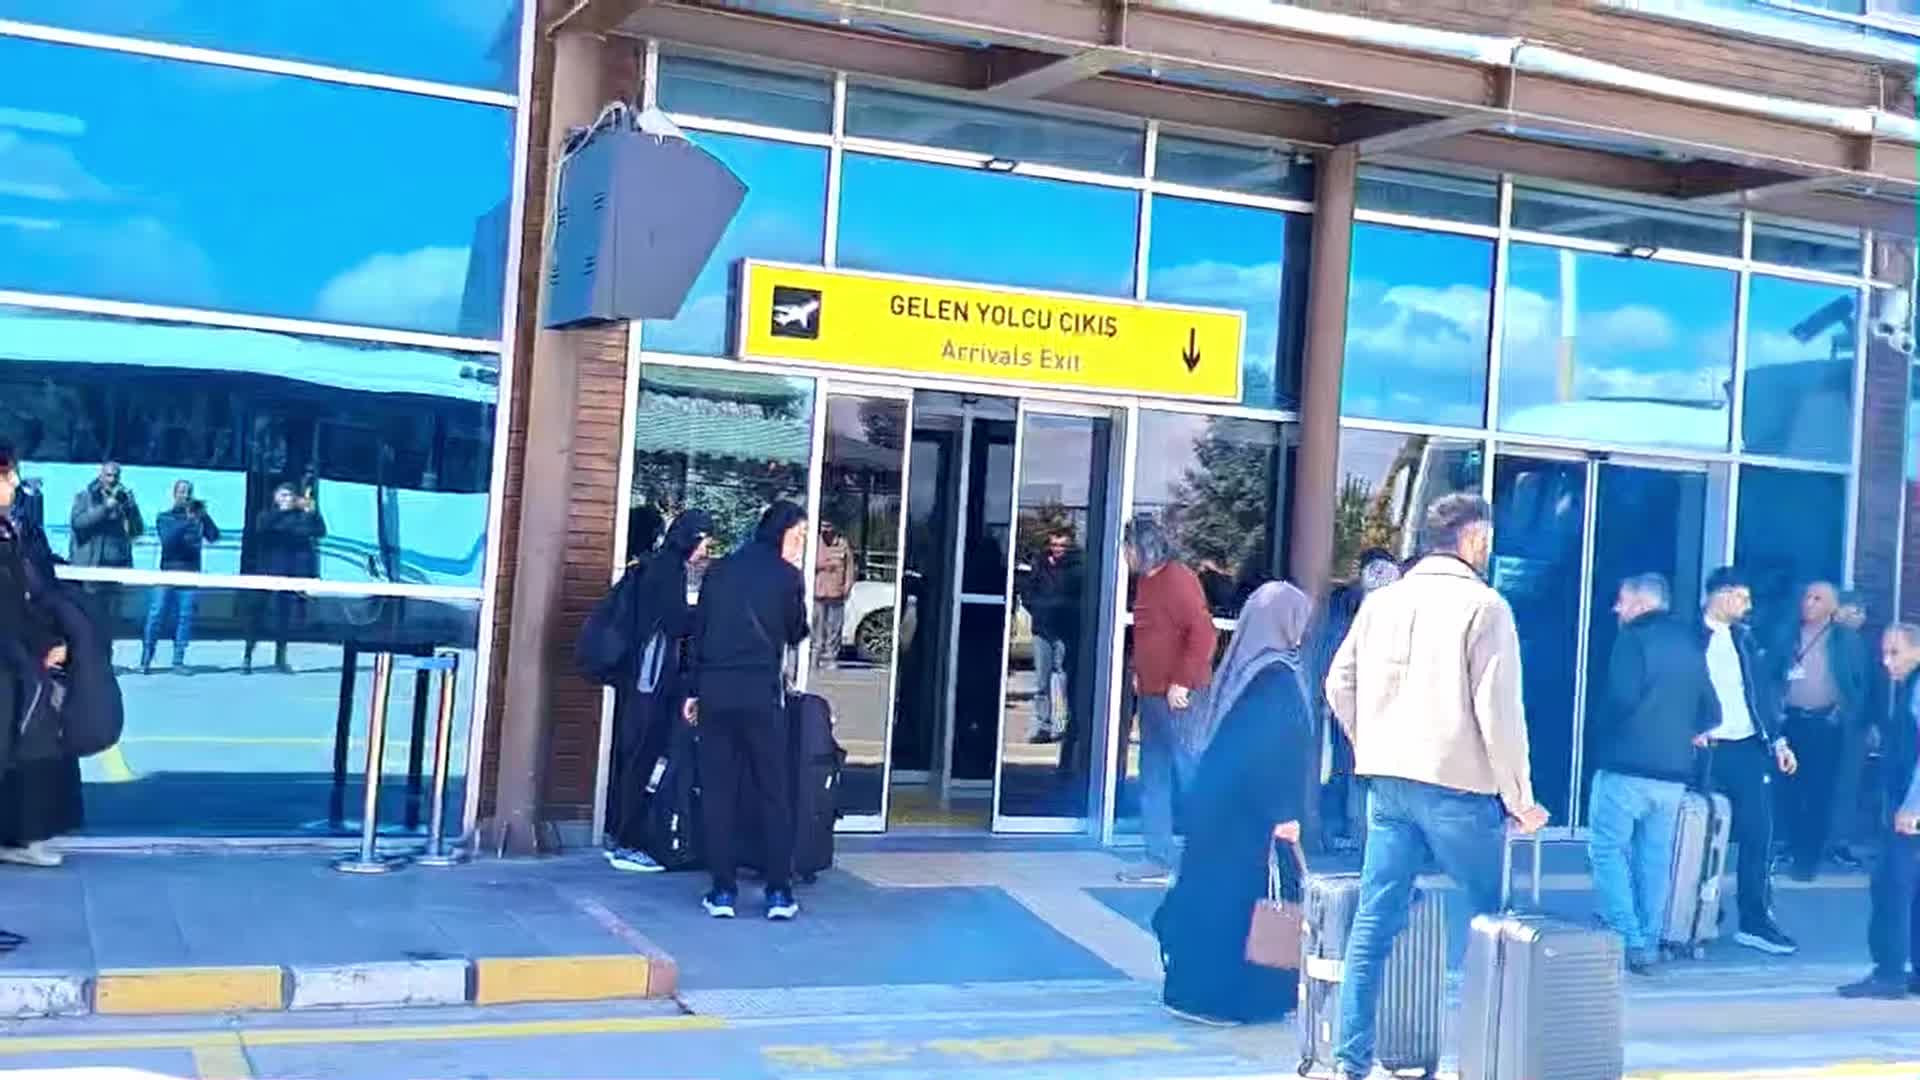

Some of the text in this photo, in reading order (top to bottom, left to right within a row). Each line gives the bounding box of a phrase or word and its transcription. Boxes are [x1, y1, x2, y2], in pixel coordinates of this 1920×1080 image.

[891, 294, 968, 322] GELEN
[976, 302, 1052, 330] YOLCU
[942, 338, 1080, 372] Arrivals Exit
